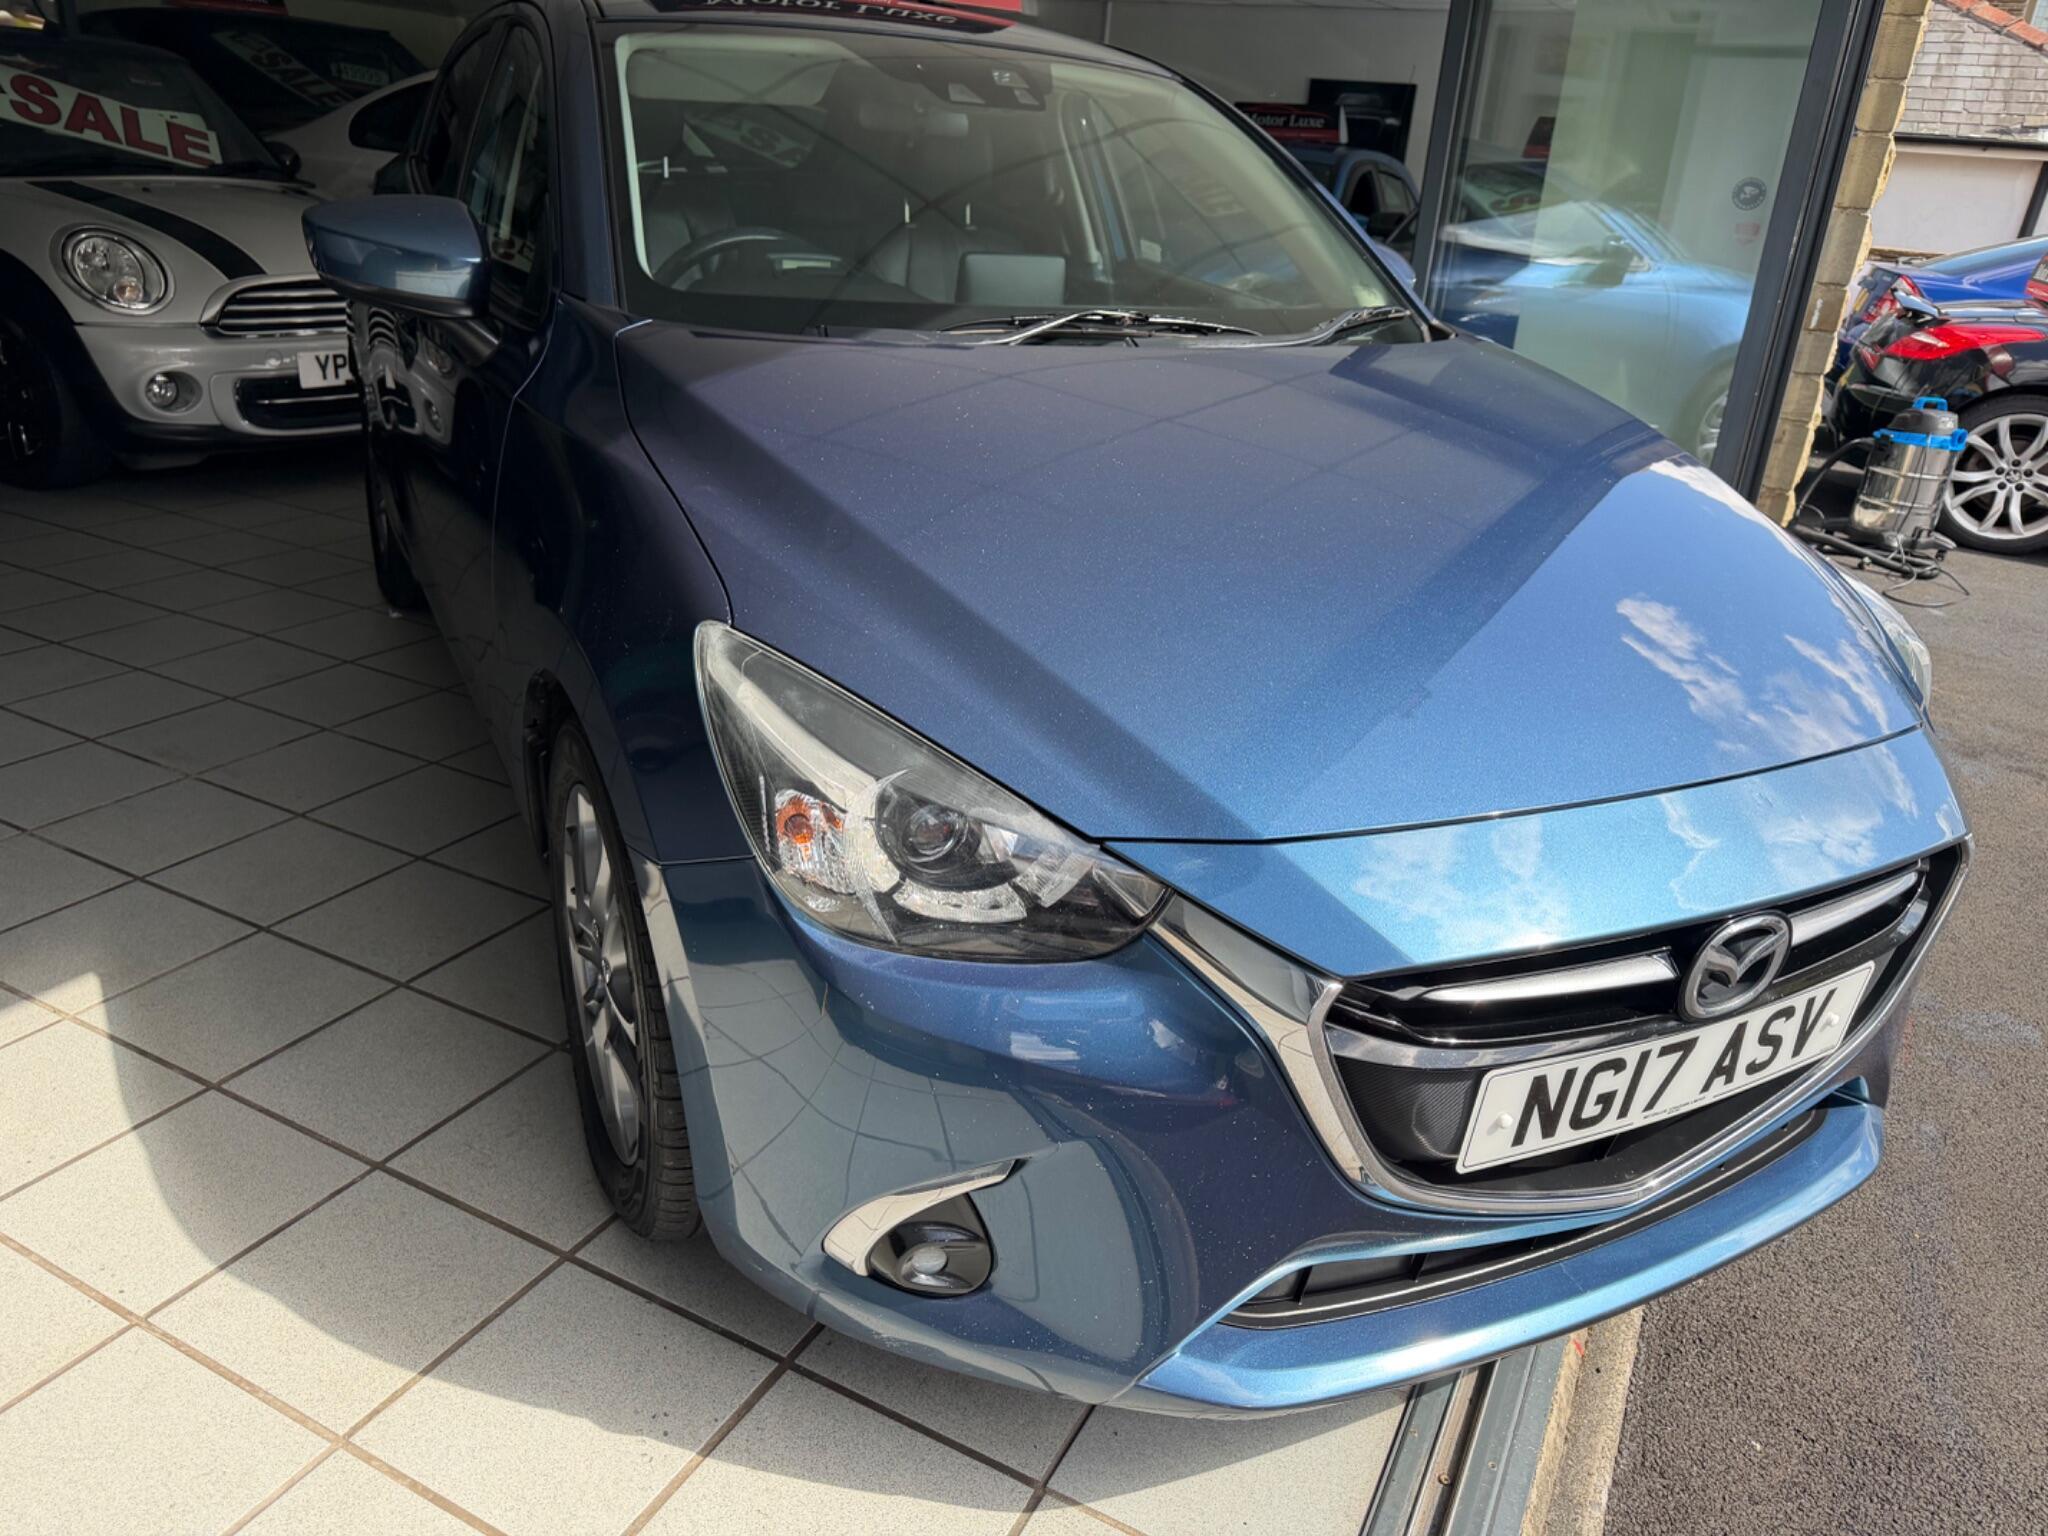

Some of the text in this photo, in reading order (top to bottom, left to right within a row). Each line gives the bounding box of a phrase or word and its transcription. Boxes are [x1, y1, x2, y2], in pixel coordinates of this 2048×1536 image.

[9, 73, 215, 166] SALE
[1290, 114, 1325, 127] Luxe
[1510, 988, 1838, 1148] NG17 ASV
